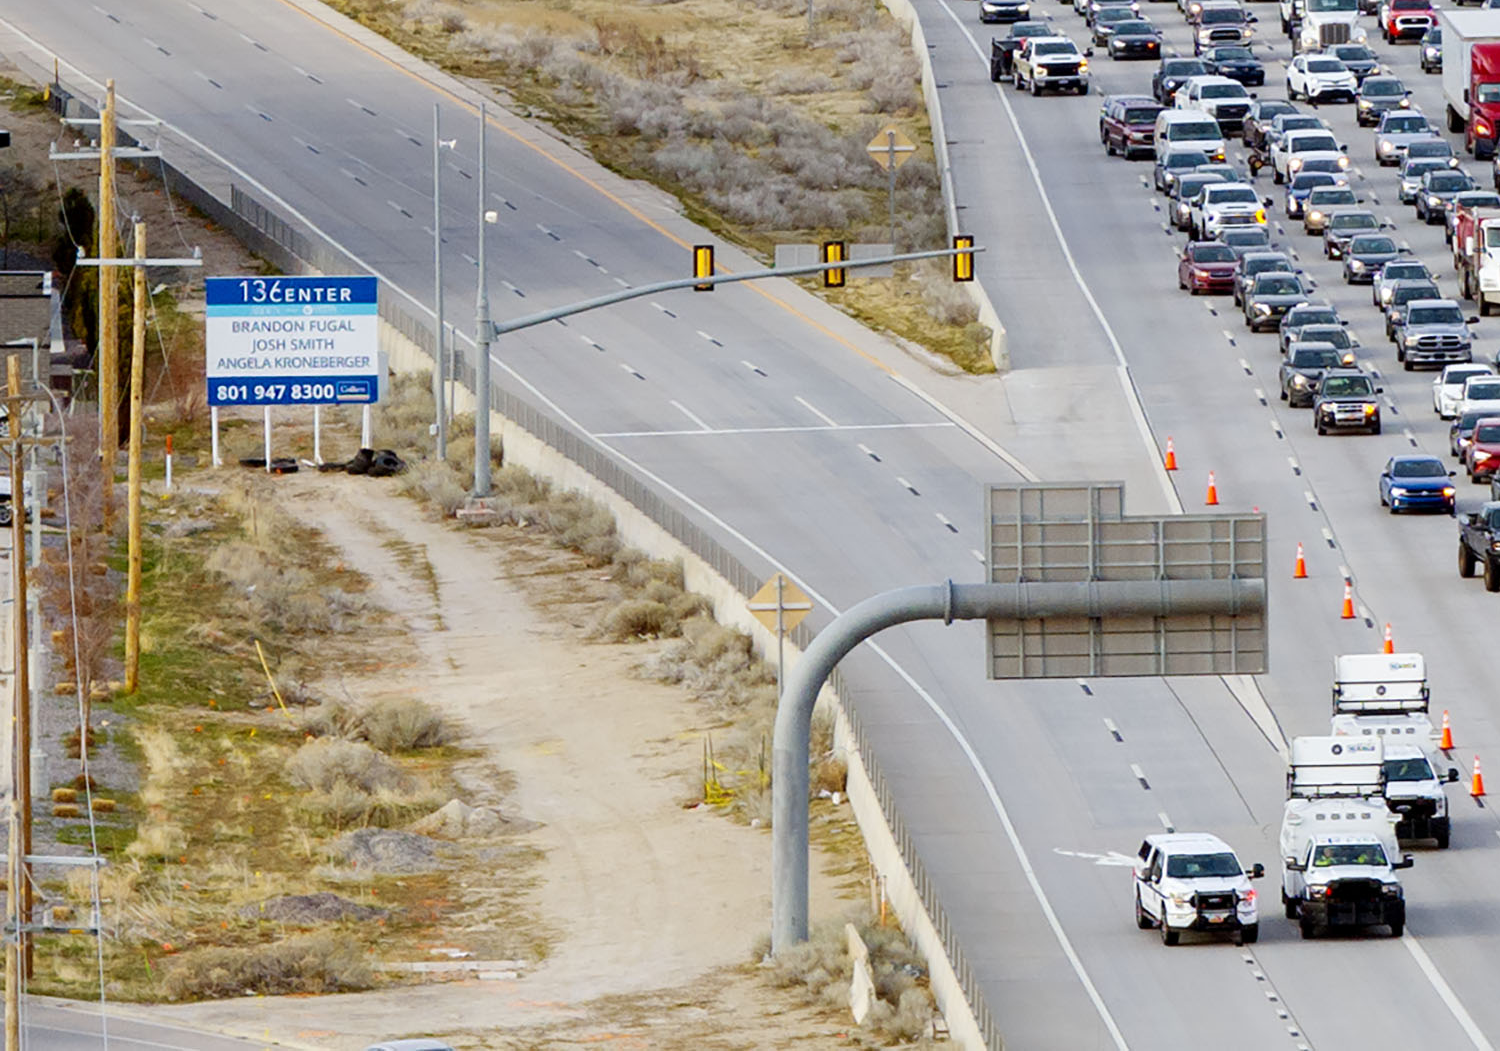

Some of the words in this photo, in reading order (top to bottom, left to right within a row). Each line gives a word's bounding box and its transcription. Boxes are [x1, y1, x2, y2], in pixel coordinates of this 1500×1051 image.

[231, 320, 304, 333] BRANDON
[309, 320, 355, 332] FUGAL
[250, 339, 286, 354] JOSH
[290, 338, 335, 350] SMITH
[217, 357, 271, 369] ANGELA
[274, 356, 370, 369] KRONEBERGER
[217, 385, 248, 400] 801
[254, 385, 287, 400] 947
[290, 384, 335, 399] 8300
